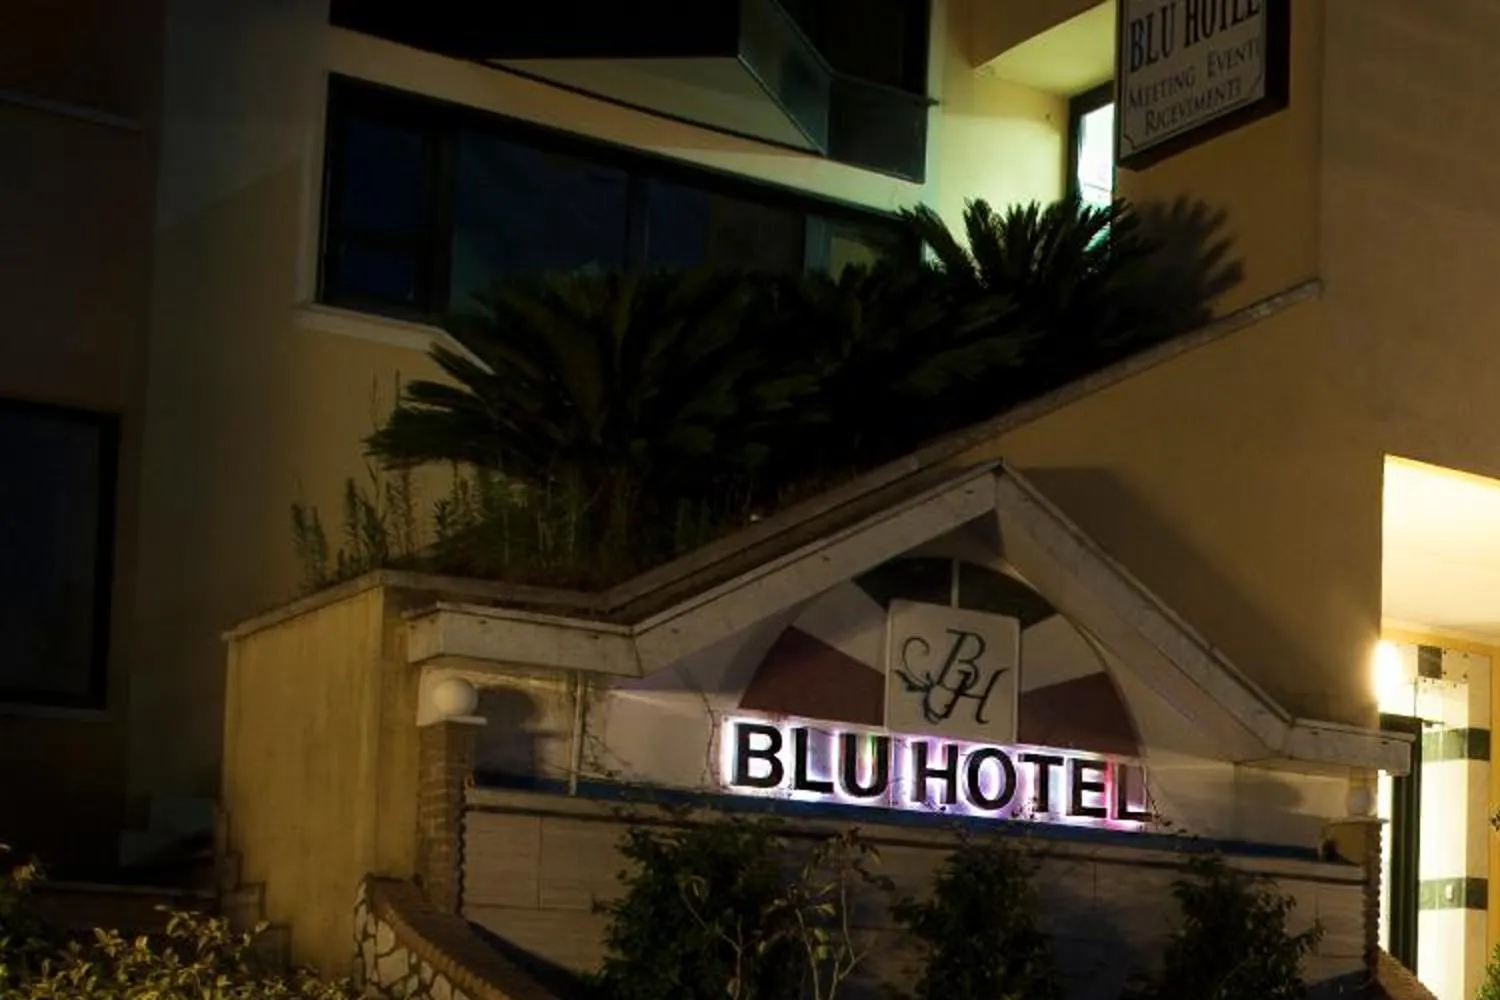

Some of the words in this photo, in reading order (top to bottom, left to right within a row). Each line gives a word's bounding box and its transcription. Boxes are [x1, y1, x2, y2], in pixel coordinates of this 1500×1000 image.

[1129, 2, 1177, 73] BLU
[1127, 65, 1197, 111] MEETING
[1144, 77, 1242, 136] RICEVIMENTI
[733, 721, 891, 799] BLU
[908, 740, 1153, 822] HOTEL
